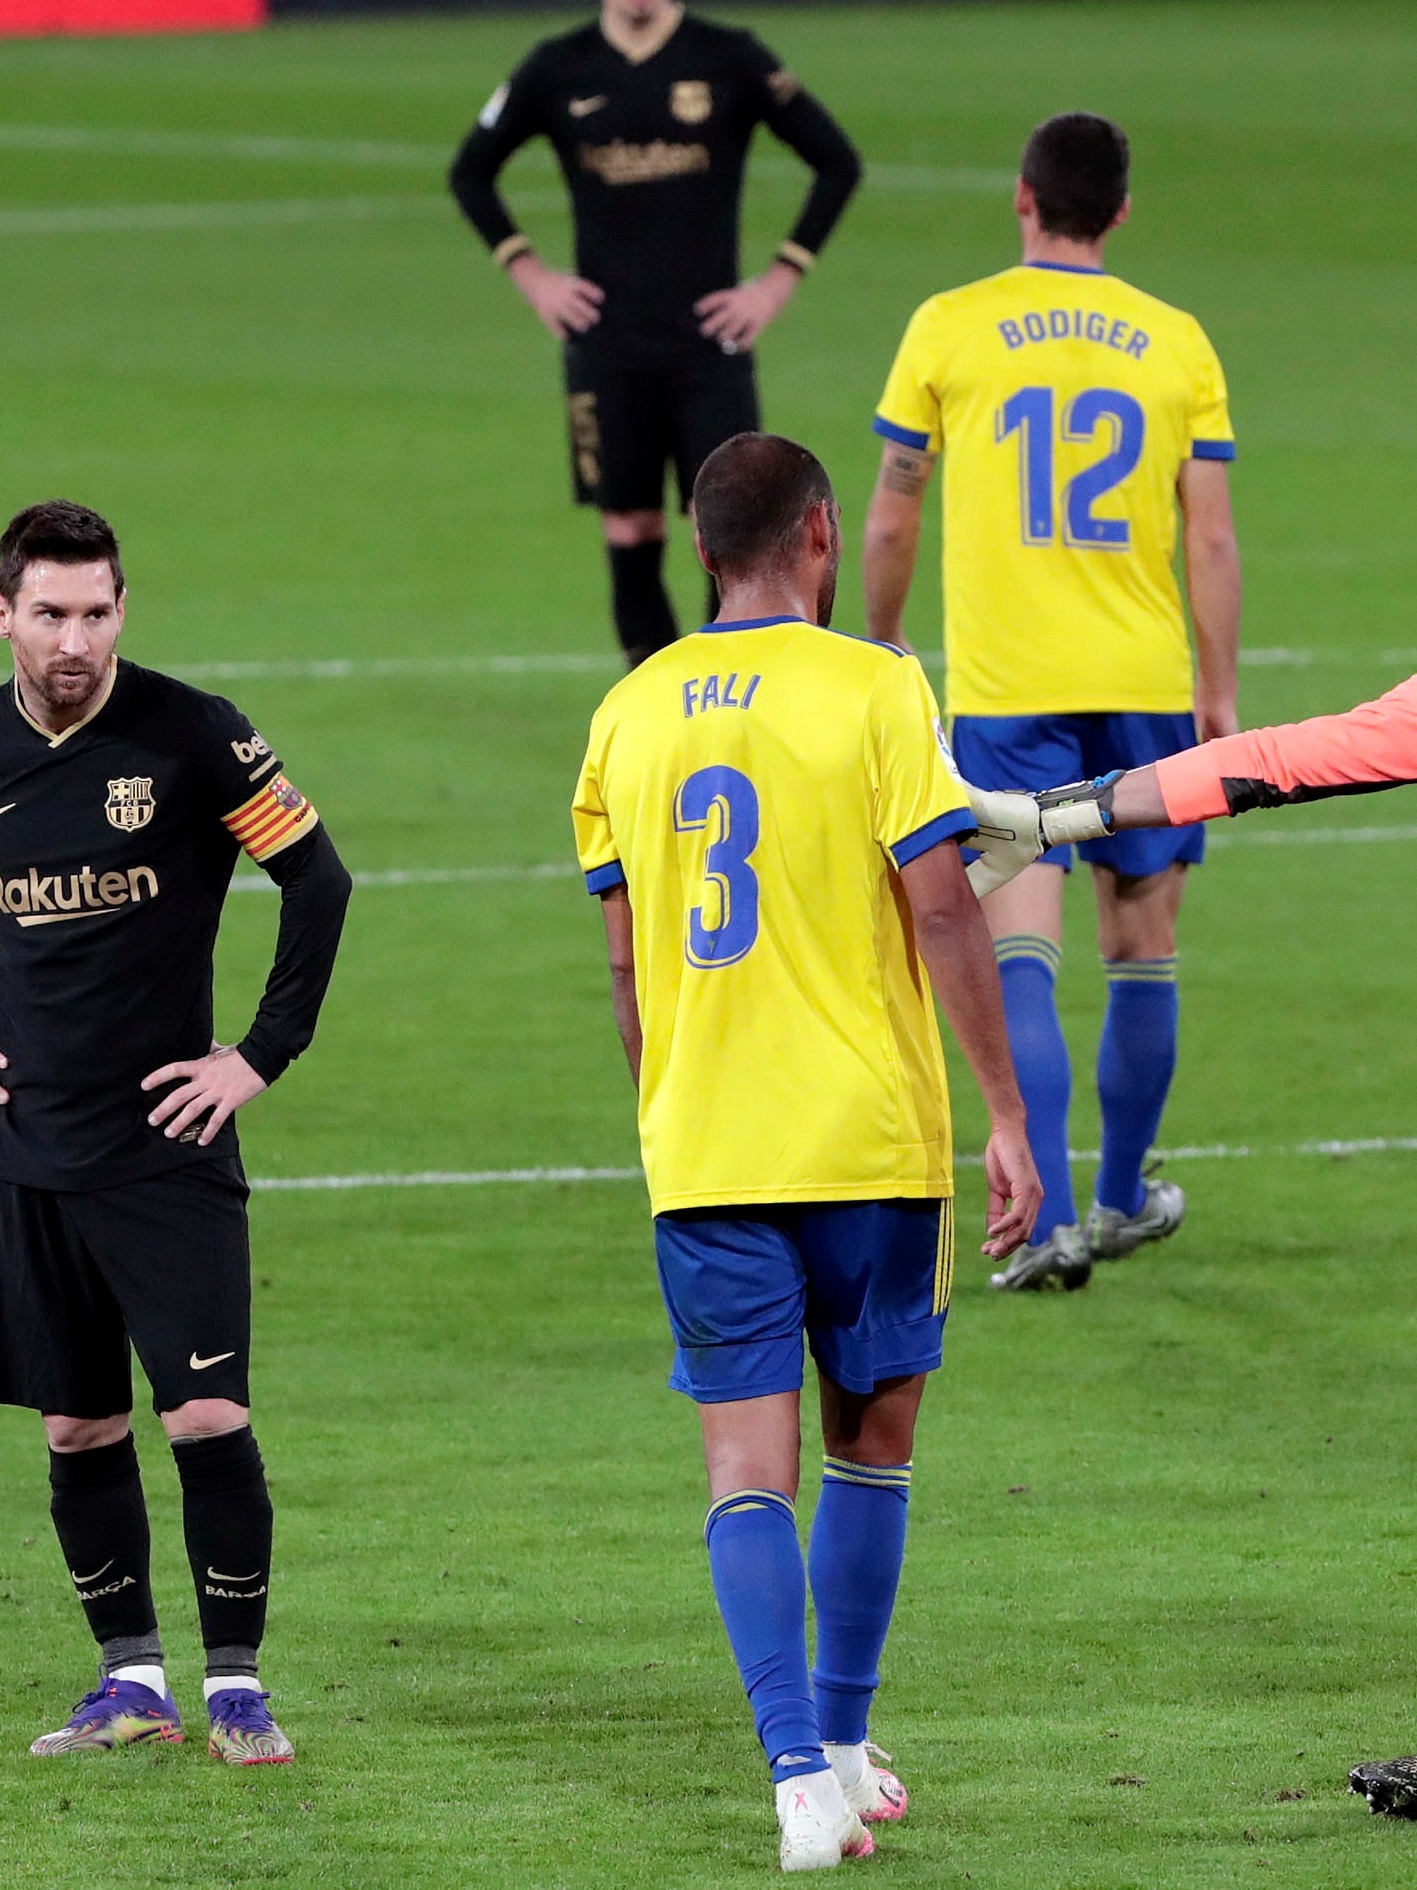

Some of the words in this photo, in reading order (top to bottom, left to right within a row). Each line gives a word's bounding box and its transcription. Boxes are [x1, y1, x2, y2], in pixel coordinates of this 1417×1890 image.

[997, 309, 1150, 360] BODIGER
[995, 386, 1145, 551] 12
[683, 673, 762, 718] FALI
[673, 765, 759, 969] 3
